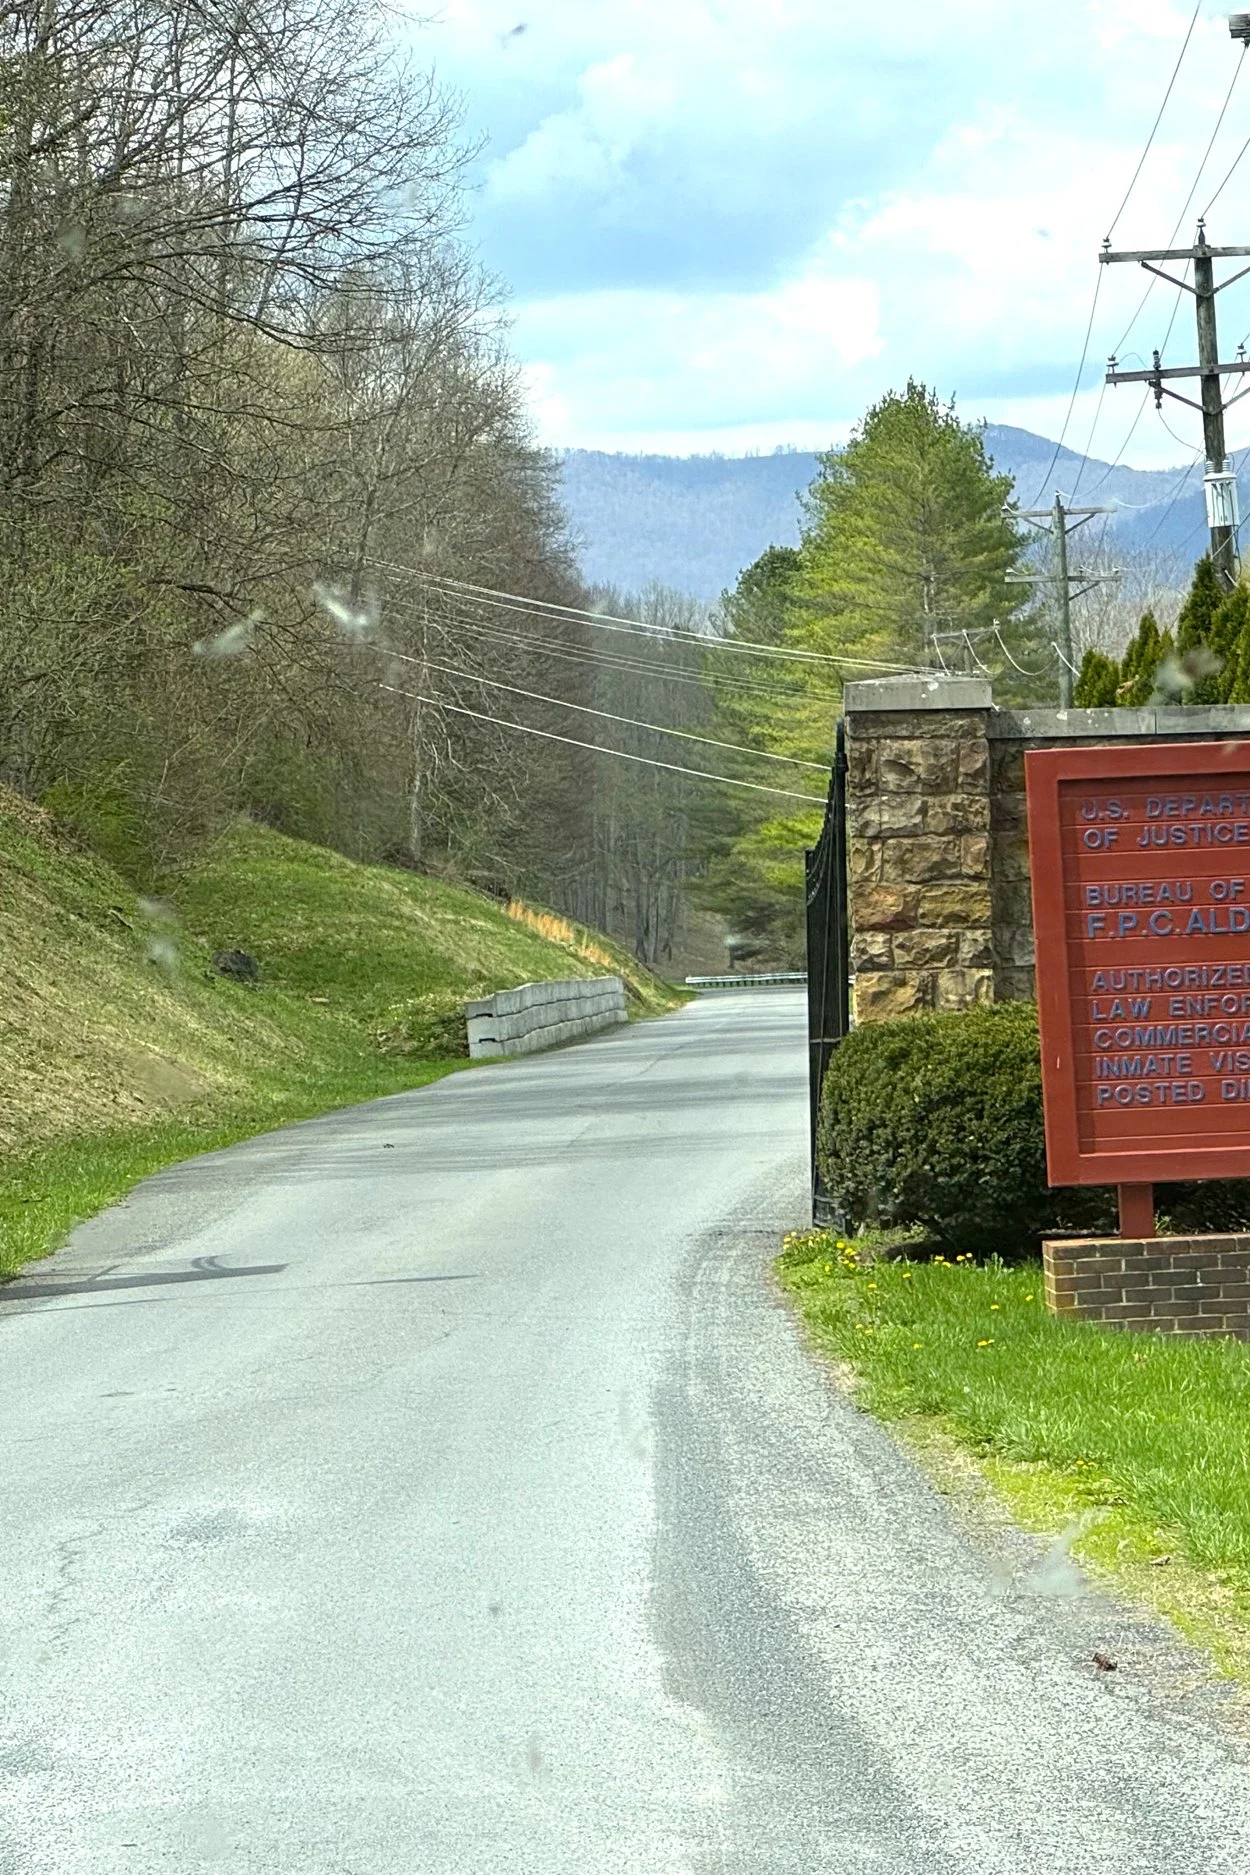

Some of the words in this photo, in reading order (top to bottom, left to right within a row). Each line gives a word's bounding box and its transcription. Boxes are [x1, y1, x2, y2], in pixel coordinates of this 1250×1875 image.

[1081, 799, 1130, 821] U.S.
[1083, 828, 1119, 849] OF
[1136, 822, 1250, 847] JUSTICE
[1086, 881, 1193, 906] BUREAU
[1210, 879, 1245, 901] OF
[1092, 999, 1151, 1021] LAW
[1095, 1054, 1193, 1078] INMATE
[1097, 1081, 1206, 1106] POSTED
